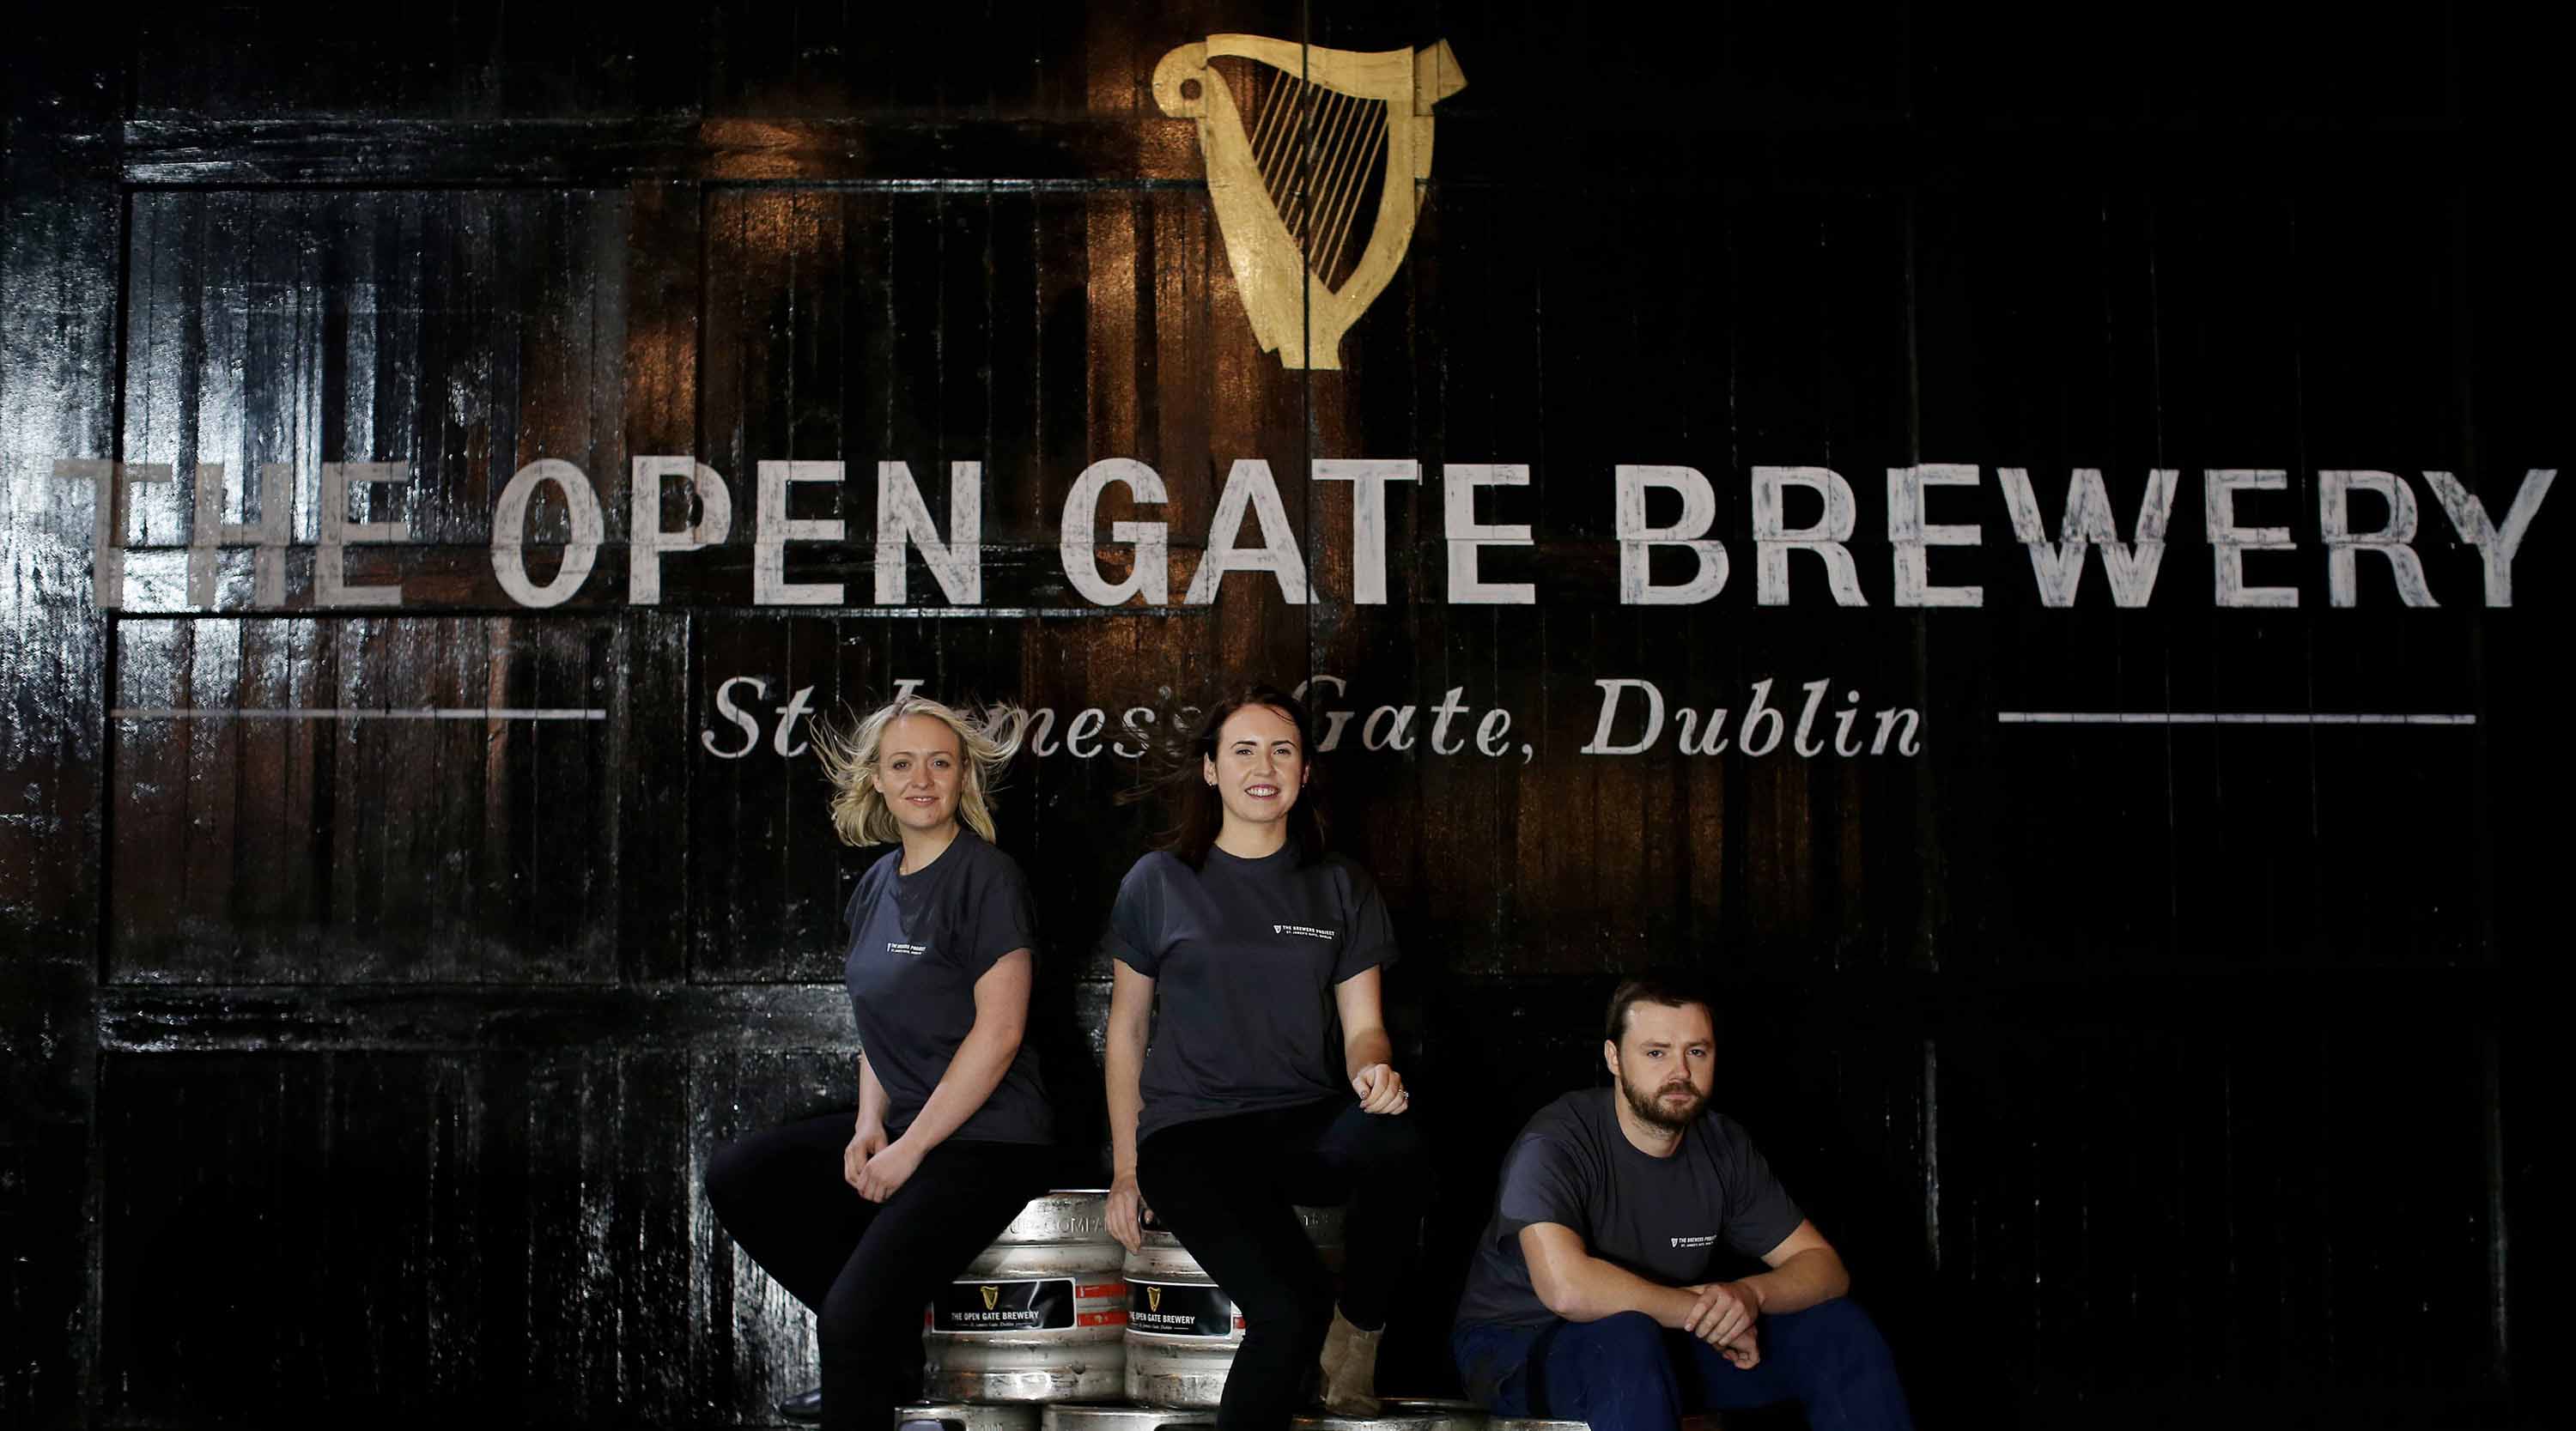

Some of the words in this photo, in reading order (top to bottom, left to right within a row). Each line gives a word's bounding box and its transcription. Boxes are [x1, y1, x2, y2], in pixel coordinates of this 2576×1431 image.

[53, 458, 408, 608] THE
[491, 455, 981, 608] OPEN
[1060, 458, 1535, 606] GATE
[1615, 463, 2557, 608] BREWERY
[701, 676, 816, 759] St
[1582, 677, 1921, 757] Dublin
[951, 1312, 963, 1321] THE
[963, 1312, 981, 1321] OPEN
[982, 1312, 1001, 1321] GATE
[1002, 1310, 1040, 1320] BREWERY
[1135, 1313, 1146, 1321] OPEN
[1147, 1313, 1162, 1323] GATE
[1163, 1314, 1195, 1325] BREWERY
